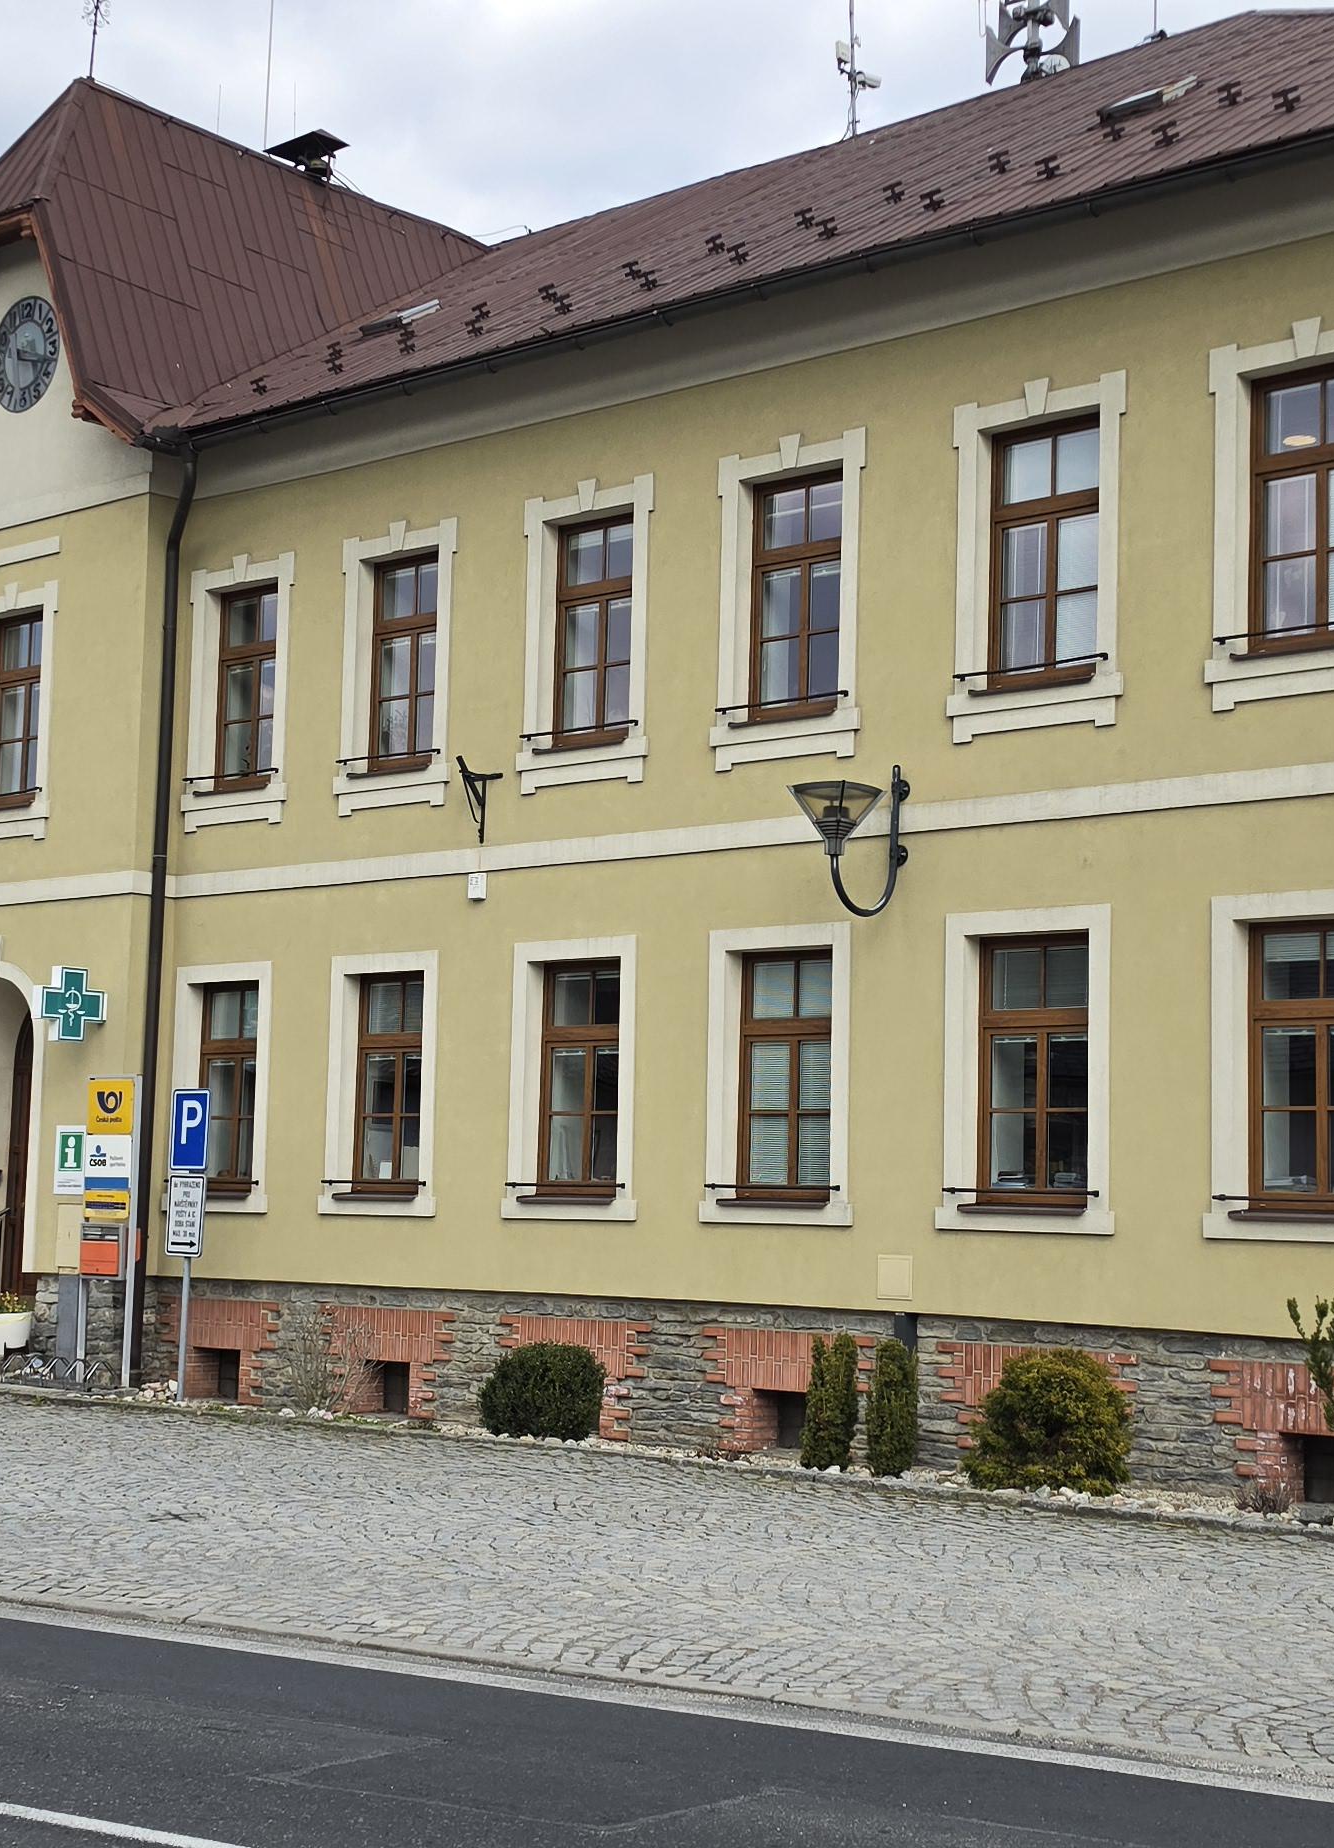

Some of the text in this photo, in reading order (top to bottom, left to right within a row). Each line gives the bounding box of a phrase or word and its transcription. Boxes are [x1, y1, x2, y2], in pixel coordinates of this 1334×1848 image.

[45, 317, 54, 334] 2
[49, 339, 58, 356] 3
[33, 382, 41, 399] 5
[180, 1100, 203, 1145] P
[89, 1158, 107, 1167] ČSOB
